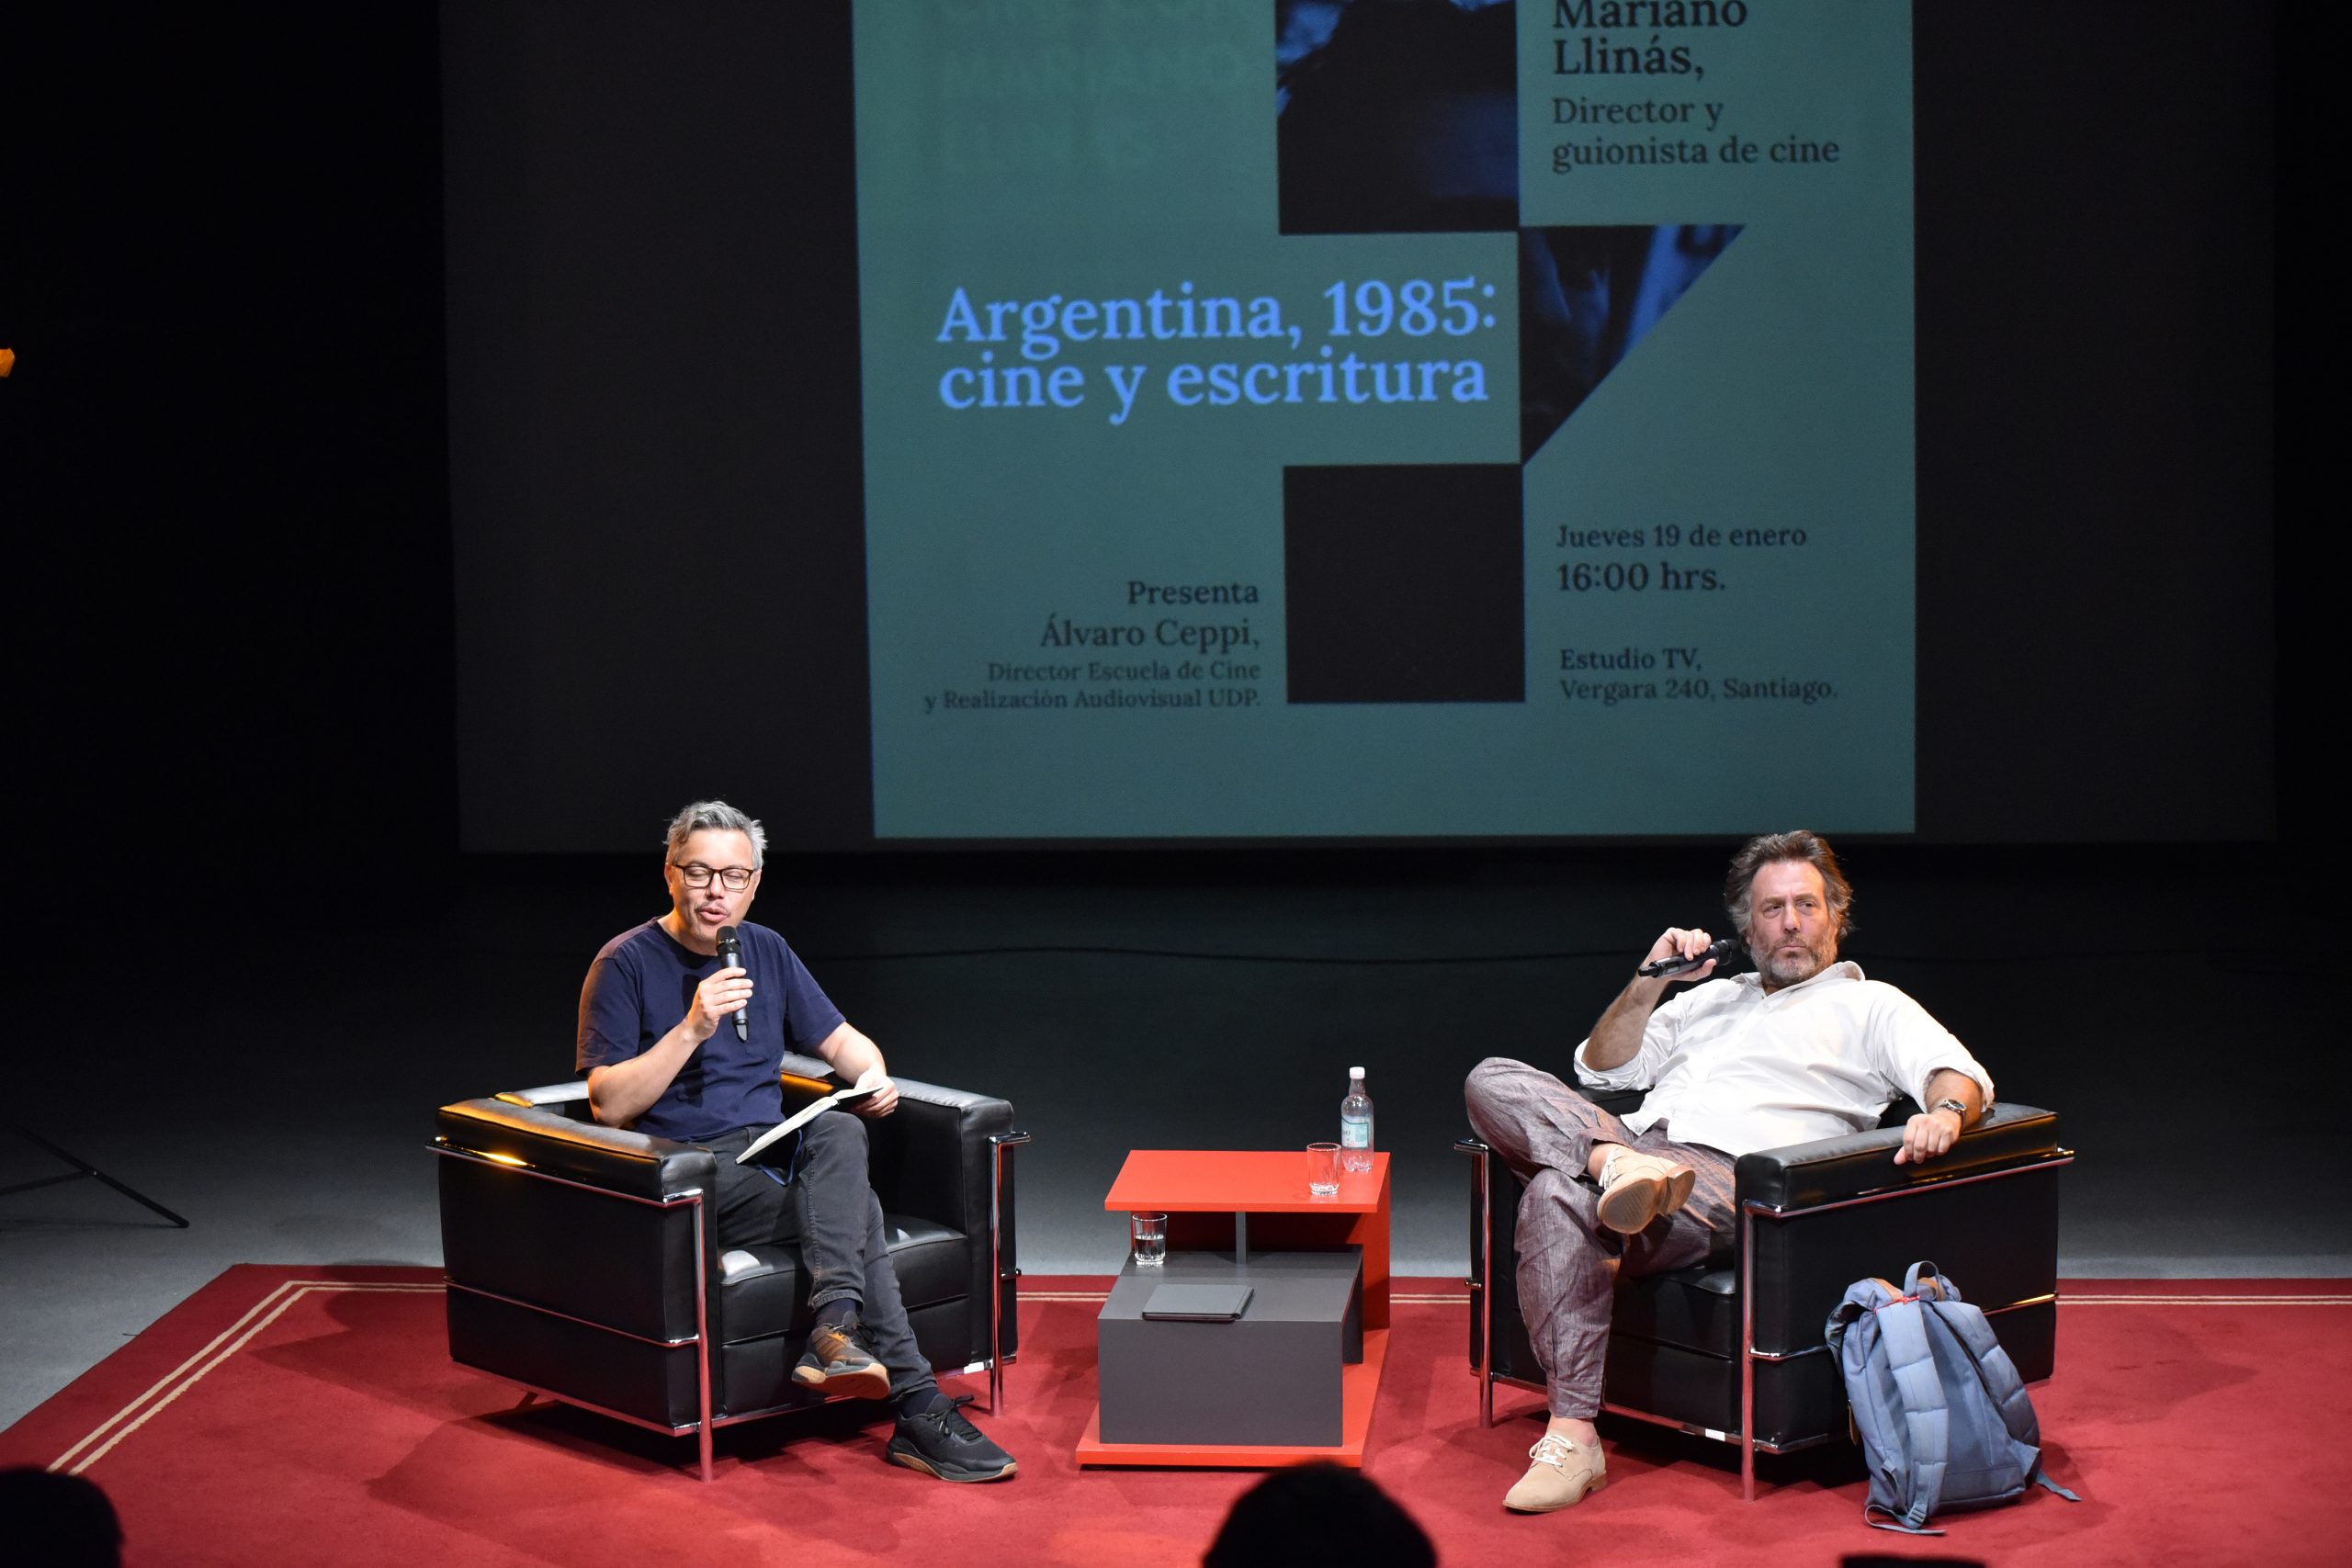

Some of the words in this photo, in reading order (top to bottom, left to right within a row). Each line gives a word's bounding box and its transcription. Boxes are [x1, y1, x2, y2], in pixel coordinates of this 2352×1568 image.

[1555, 0, 1747, 28] Mariano
[1555, 34, 1703, 80] Llinás,
[1554, 97, 1695, 124] Director
[1704, 103, 1724, 131] y
[1553, 136, 1709, 174] guionista
[1719, 135, 1758, 164] de
[1770, 134, 1839, 163] cine
[936, 281, 1302, 361] Argentina,
[1325, 276, 1495, 336] 1985:
[939, 351, 1085, 410] cine
[1105, 365, 1146, 424] y
[1167, 344, 1488, 406] escritura
[1557, 525, 1645, 547] Jueves
[1655, 525, 1680, 547] 19
[1689, 524, 1721, 547] de
[1729, 529, 1807, 547] enero
[1558, 563, 1649, 592] 16:00
[1661, 561, 1725, 591] hrs.
[1128, 581, 1259, 604] Presenta
[1041, 613, 1145, 647] Álvaro
[1155, 618, 1259, 655] Ceppi,
[989, 662, 1081, 682] Director
[1089, 660, 1170, 681] Escuela
[1177, 660, 1203, 680] de
[1210, 660, 1261, 680] Cine
[1561, 648, 1656, 670] Estudio
[1662, 648, 1702, 671] TV,
[923, 695, 938, 716] y
[944, 689, 1068, 709] Realización
[1074, 688, 1202, 708] Audiovisual
[1208, 688, 1260, 707] UDP.
[1560, 680, 1657, 706] Vergara
[1666, 679, 1715, 701] 240,
[1724, 677, 1838, 705] Santiago.
